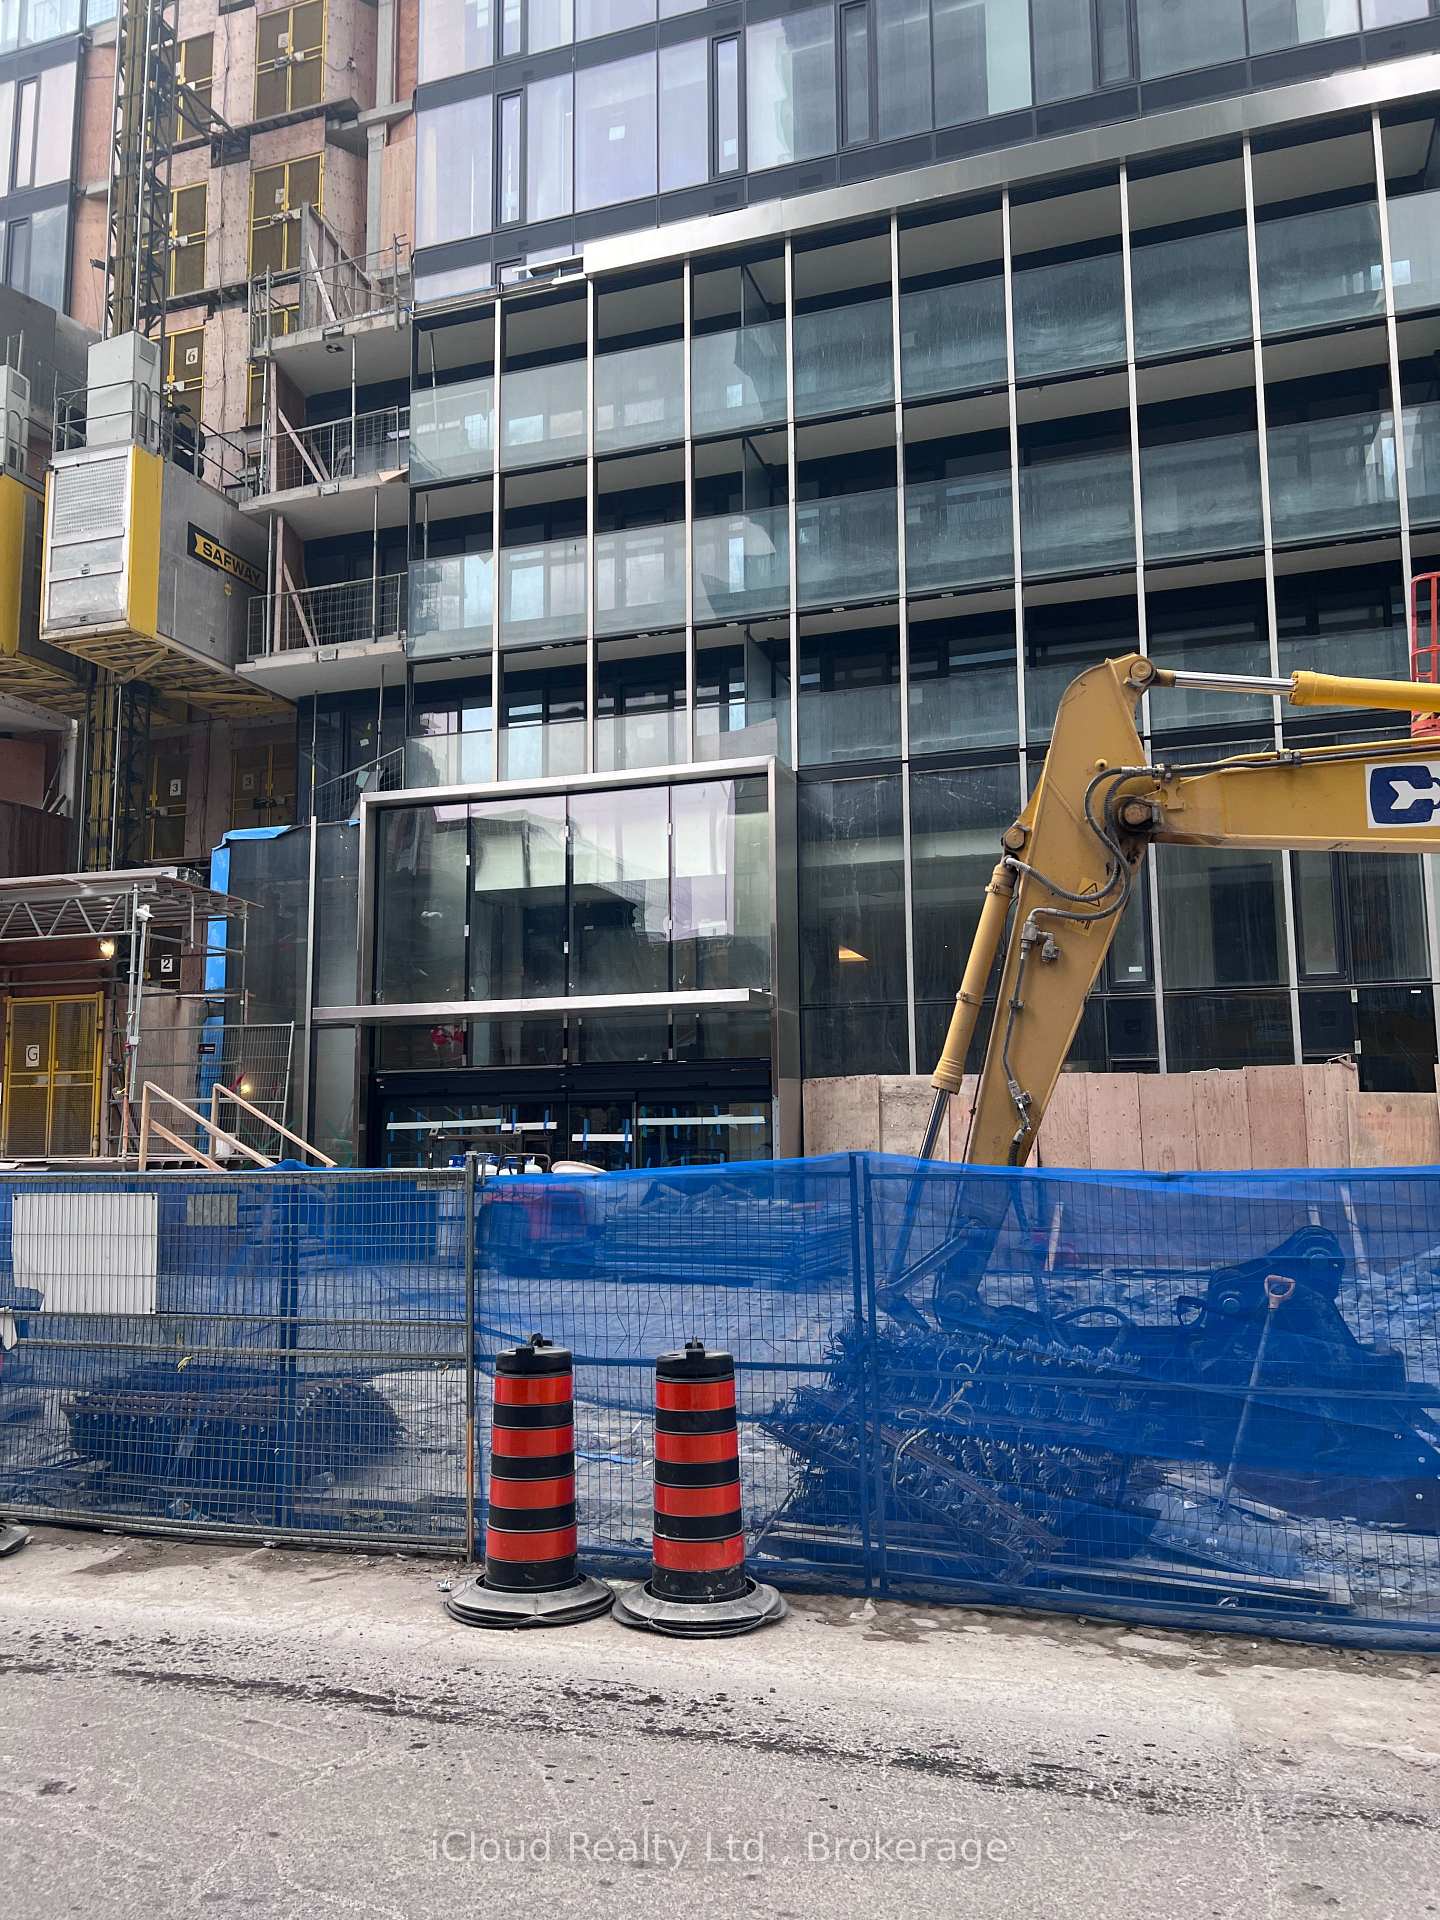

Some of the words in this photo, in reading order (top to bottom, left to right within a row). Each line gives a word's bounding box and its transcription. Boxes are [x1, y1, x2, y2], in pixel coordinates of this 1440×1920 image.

[187, 351, 196, 363] 6
[202, 541, 261, 586] SAFWAY
[171, 783, 179, 793] 3
[162, 958, 171, 970] 2
[27, 1046, 38, 1062] G
